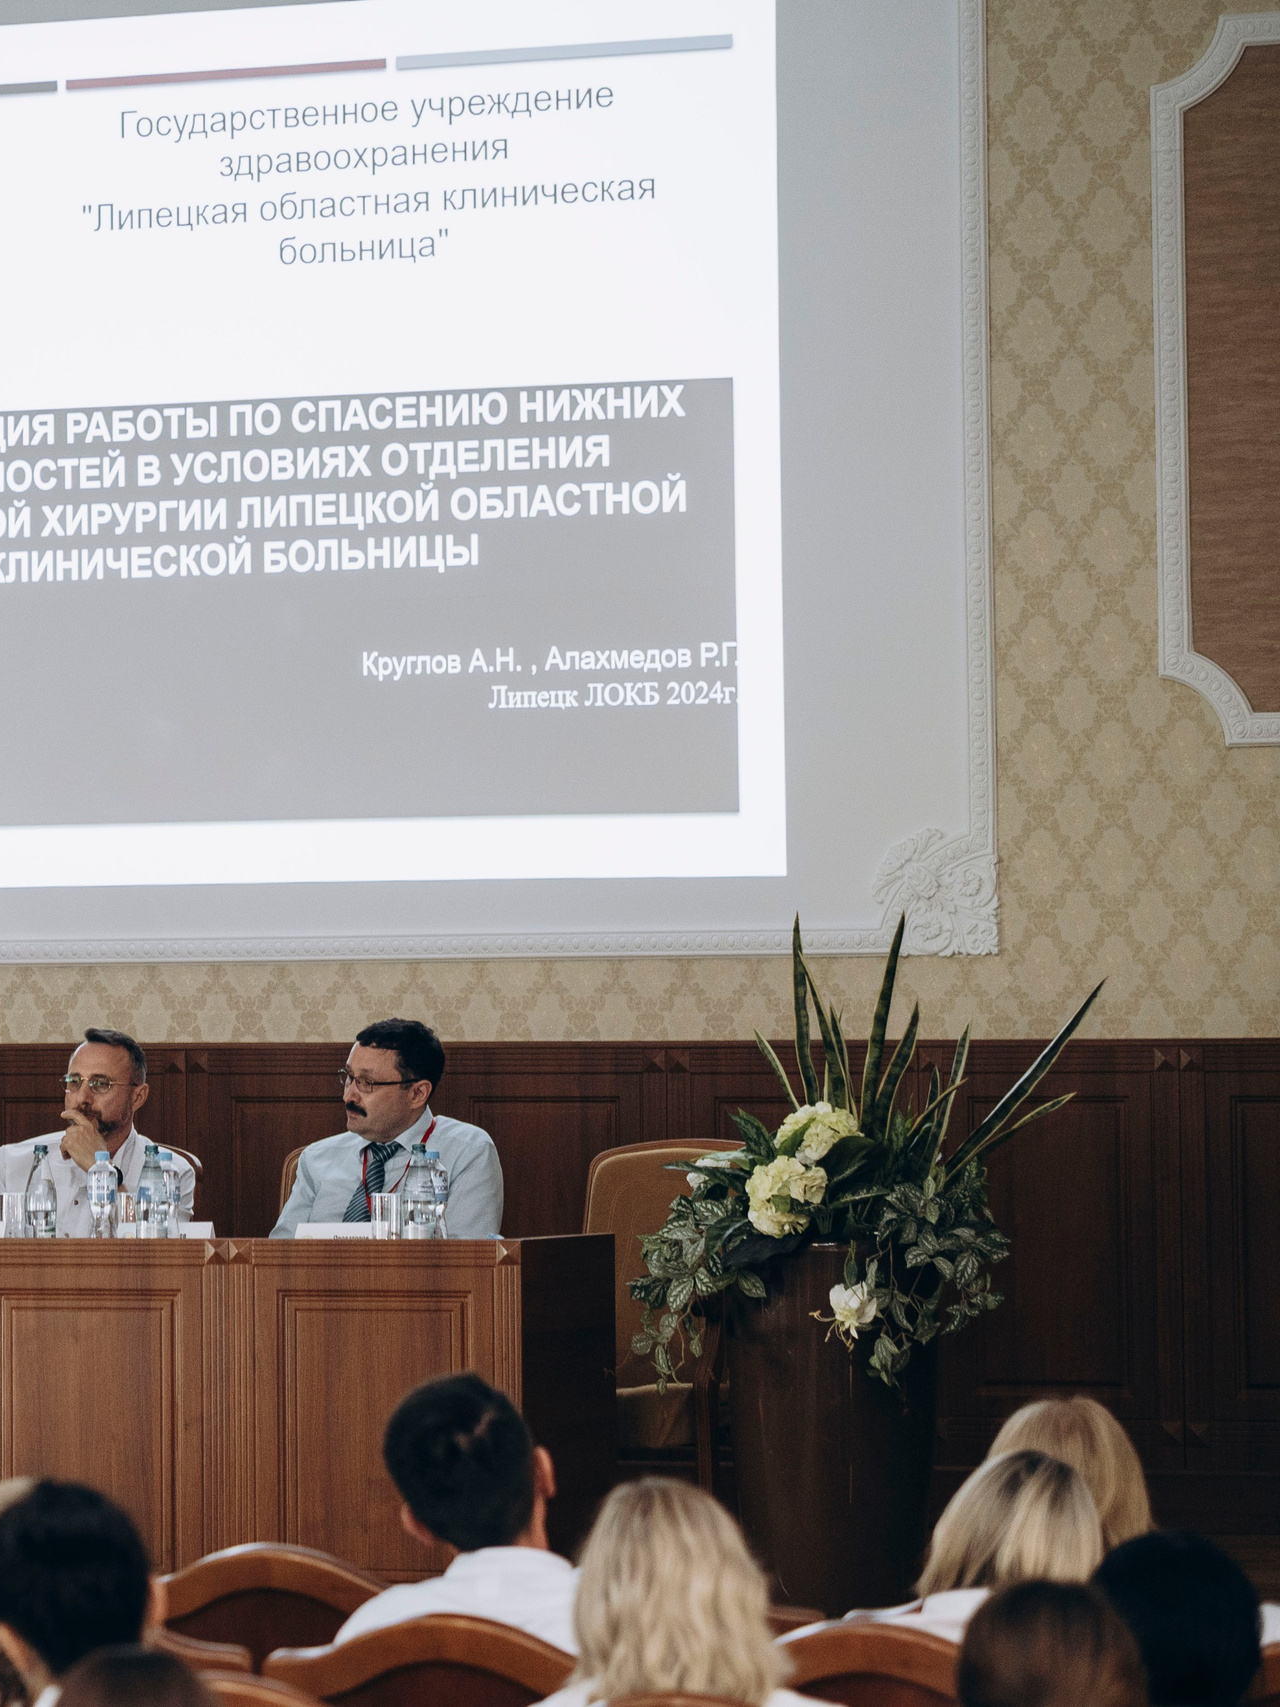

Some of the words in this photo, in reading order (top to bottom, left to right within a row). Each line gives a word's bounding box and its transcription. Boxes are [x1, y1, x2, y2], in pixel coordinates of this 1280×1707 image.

[120, 100, 399, 144] Государственное
[410, 84, 614, 129] учреждение
[219, 138, 509, 183] здравоохранения
[81, 202, 248, 233] "Липецкая
[259, 190, 430, 222] областная
[442, 177, 656, 212] клиническая
[279, 228, 450, 266] больница"
[66, 404, 219, 445] РАБОТЫ
[228, 401, 282, 438] ПО
[291, 391, 509, 434] СПАСЕНИЮ
[518, 383, 686, 424] НИЖНИХ
[137, 453, 162, 488] В
[169, 443, 373, 487] УСЛОВИЯХ
[380, 433, 610, 481] ОТДЕЛЕНИЯ
[40, 496, 228, 539] ХИРУРГИИ
[236, 481, 440, 531] ЛИПЕЦКОЙ
[450, 471, 688, 522] ОБЛАСТНОЙ
[263, 532, 480, 575] БОЛЬНИЦЫ
[362, 649, 462, 682] Круглов
[544, 644, 693, 674] Алахмедов
[487, 684, 579, 711] Липецк
[584, 681, 661, 707] ЛОКБ
